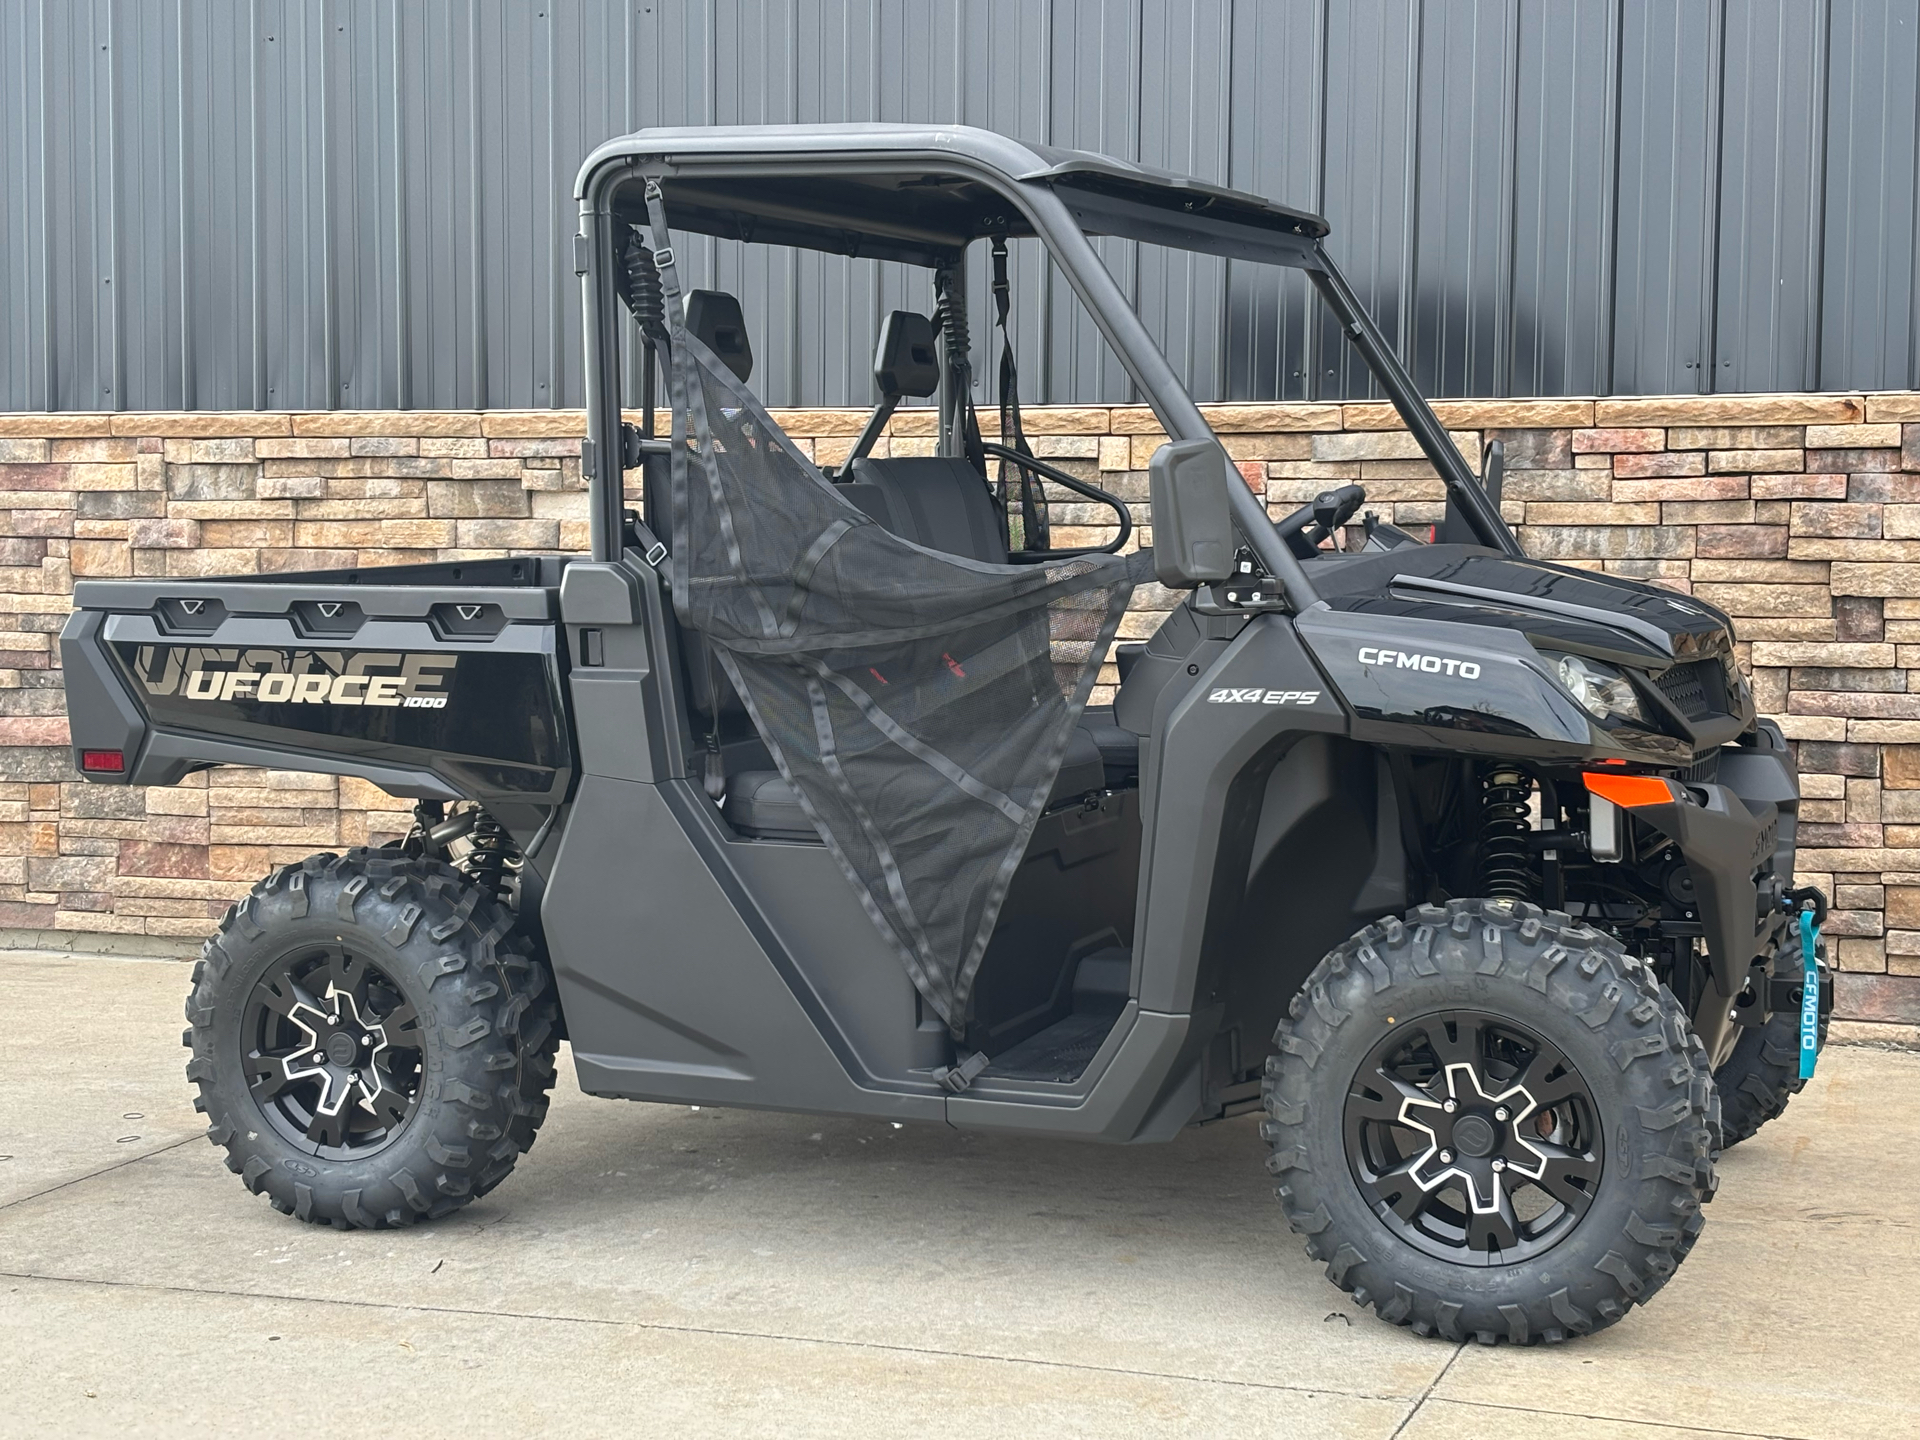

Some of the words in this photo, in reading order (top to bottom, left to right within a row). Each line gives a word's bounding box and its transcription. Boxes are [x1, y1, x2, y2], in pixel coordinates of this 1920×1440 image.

[1357, 647, 1481, 680] CFMOTO
[186, 671, 407, 707] UFORCE
[403, 697, 447, 709] 1000
[1262, 691, 1321, 705] EPS
[1803, 971, 1818, 1050] CFMOTO
